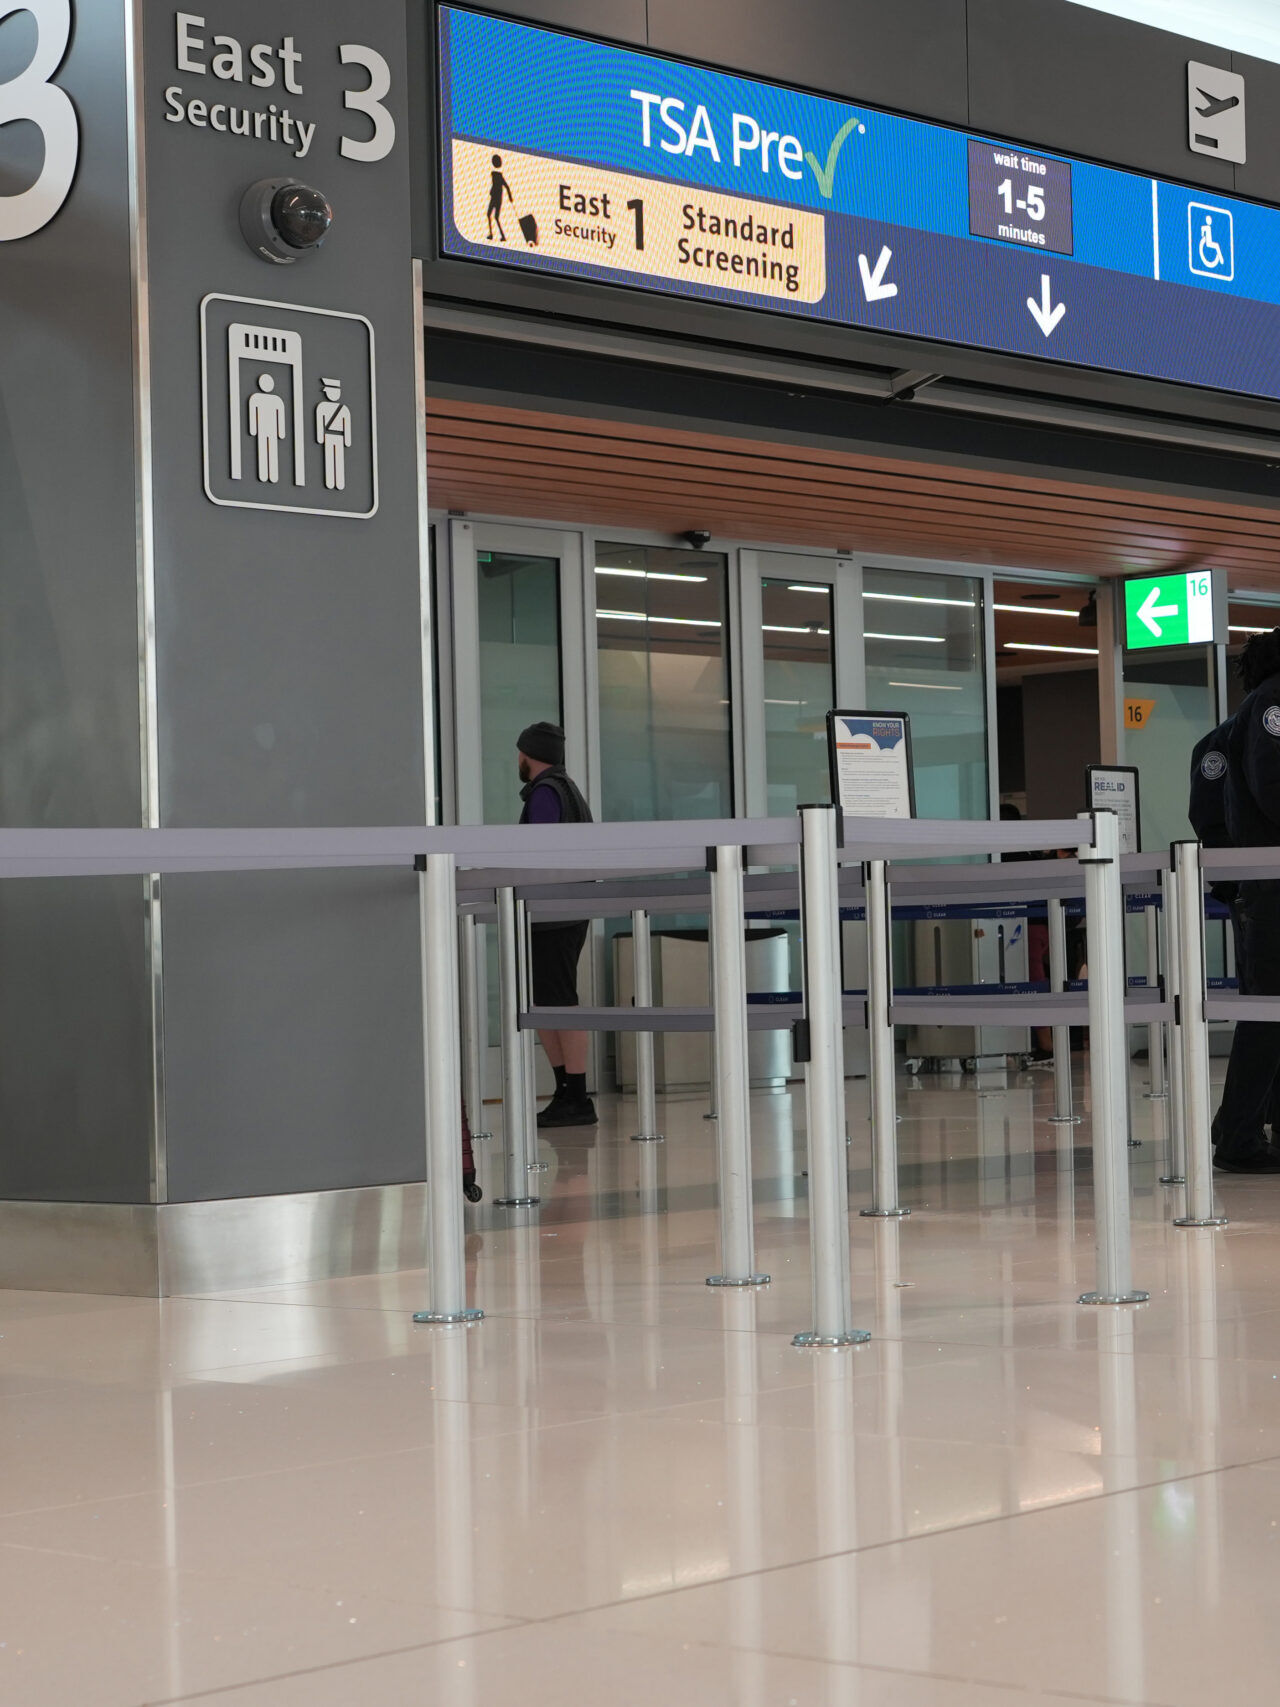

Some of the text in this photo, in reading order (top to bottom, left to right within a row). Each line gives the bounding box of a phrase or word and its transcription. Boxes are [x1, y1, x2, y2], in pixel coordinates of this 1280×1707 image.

[175, 11, 304, 95] East
[165, 86, 316, 157] Security
[339, 44, 396, 163] 3
[630, 89, 720, 163] TSA
[993, 151, 1047, 175] wait time
[558, 183, 611, 219] East
[997, 179, 1046, 221] 1-5
[554, 218, 616, 249] Security
[626, 199, 645, 251] 1
[682, 204, 794, 250] Standard
[997, 222, 1046, 245] minutes
[678, 238, 799, 291] Screening
[1190, 578, 1208, 596] 16
[872, 728, 900, 737] RIGHTS
[1128, 706, 1142, 722] 16
[1094, 782, 1125, 792] REAL ID
